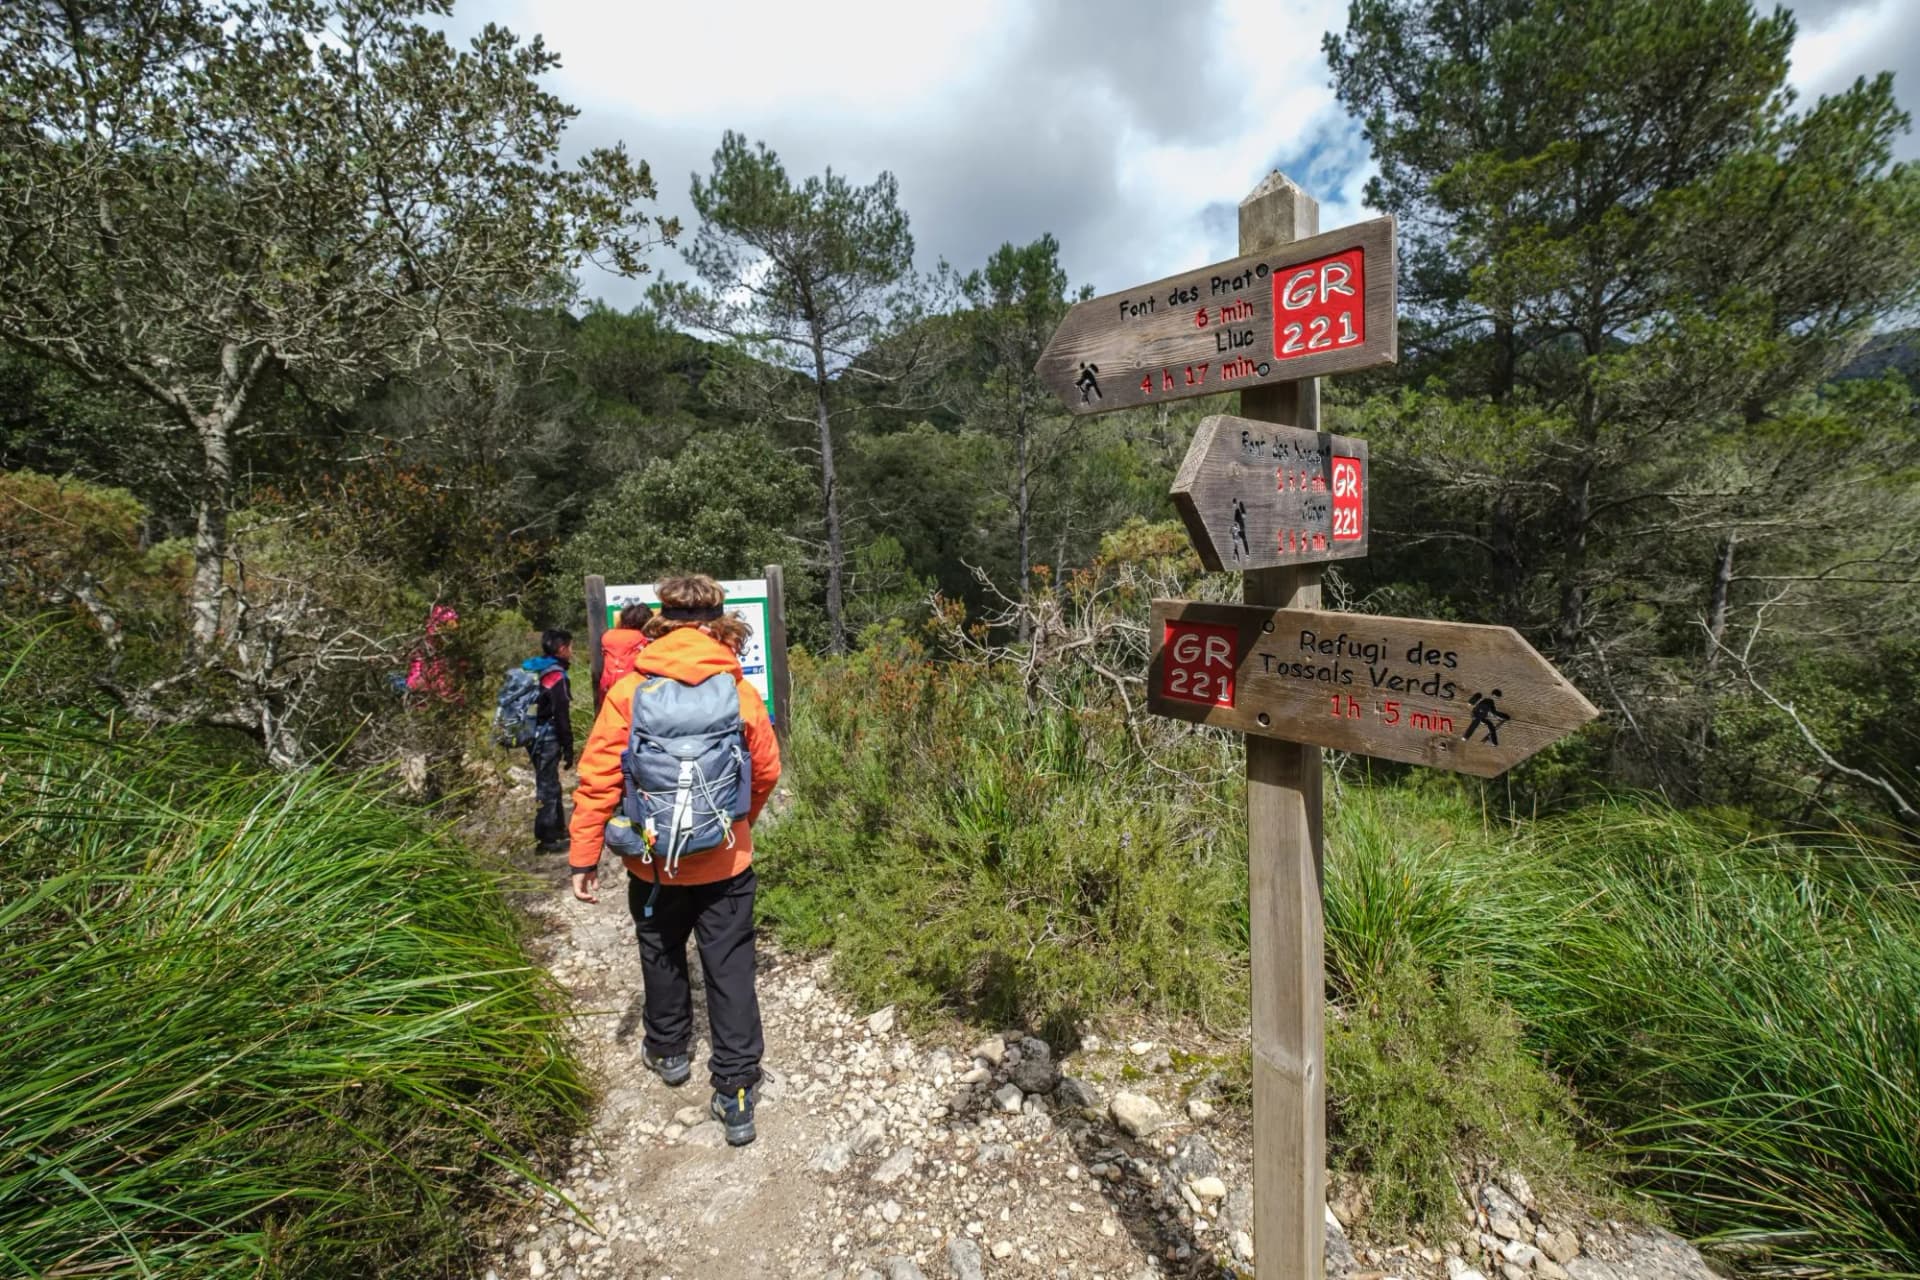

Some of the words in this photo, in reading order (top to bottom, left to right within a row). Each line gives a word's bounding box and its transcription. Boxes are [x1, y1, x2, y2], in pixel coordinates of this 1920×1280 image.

[1120, 296, 1156, 320] Font
[1168, 286, 1199, 306] des
[1283, 262, 1356, 311] GR
[1195, 306, 1209, 329] 6
[1220, 298, 1254, 324] min
[1215, 329, 1254, 352] Lluc
[1282, 311, 1359, 354] 221
[1140, 374, 1153, 394] 4
[1162, 367, 1175, 391] h
[1185, 363, 1209, 386] 17
[1221, 354, 1257, 381] min
[1333, 464, 1358, 499] GR
[1333, 507, 1358, 536] 221
[1173, 634, 1232, 669] GR
[1300, 630, 1388, 665] Refugi
[1406, 641, 1458, 669] des
[1170, 668, 1230, 702] 221
[1258, 653, 1354, 685] Tossals
[1369, 667, 1457, 701] Verds
[1384, 700, 1401, 728] 5
[1410, 710, 1453, 734] min
